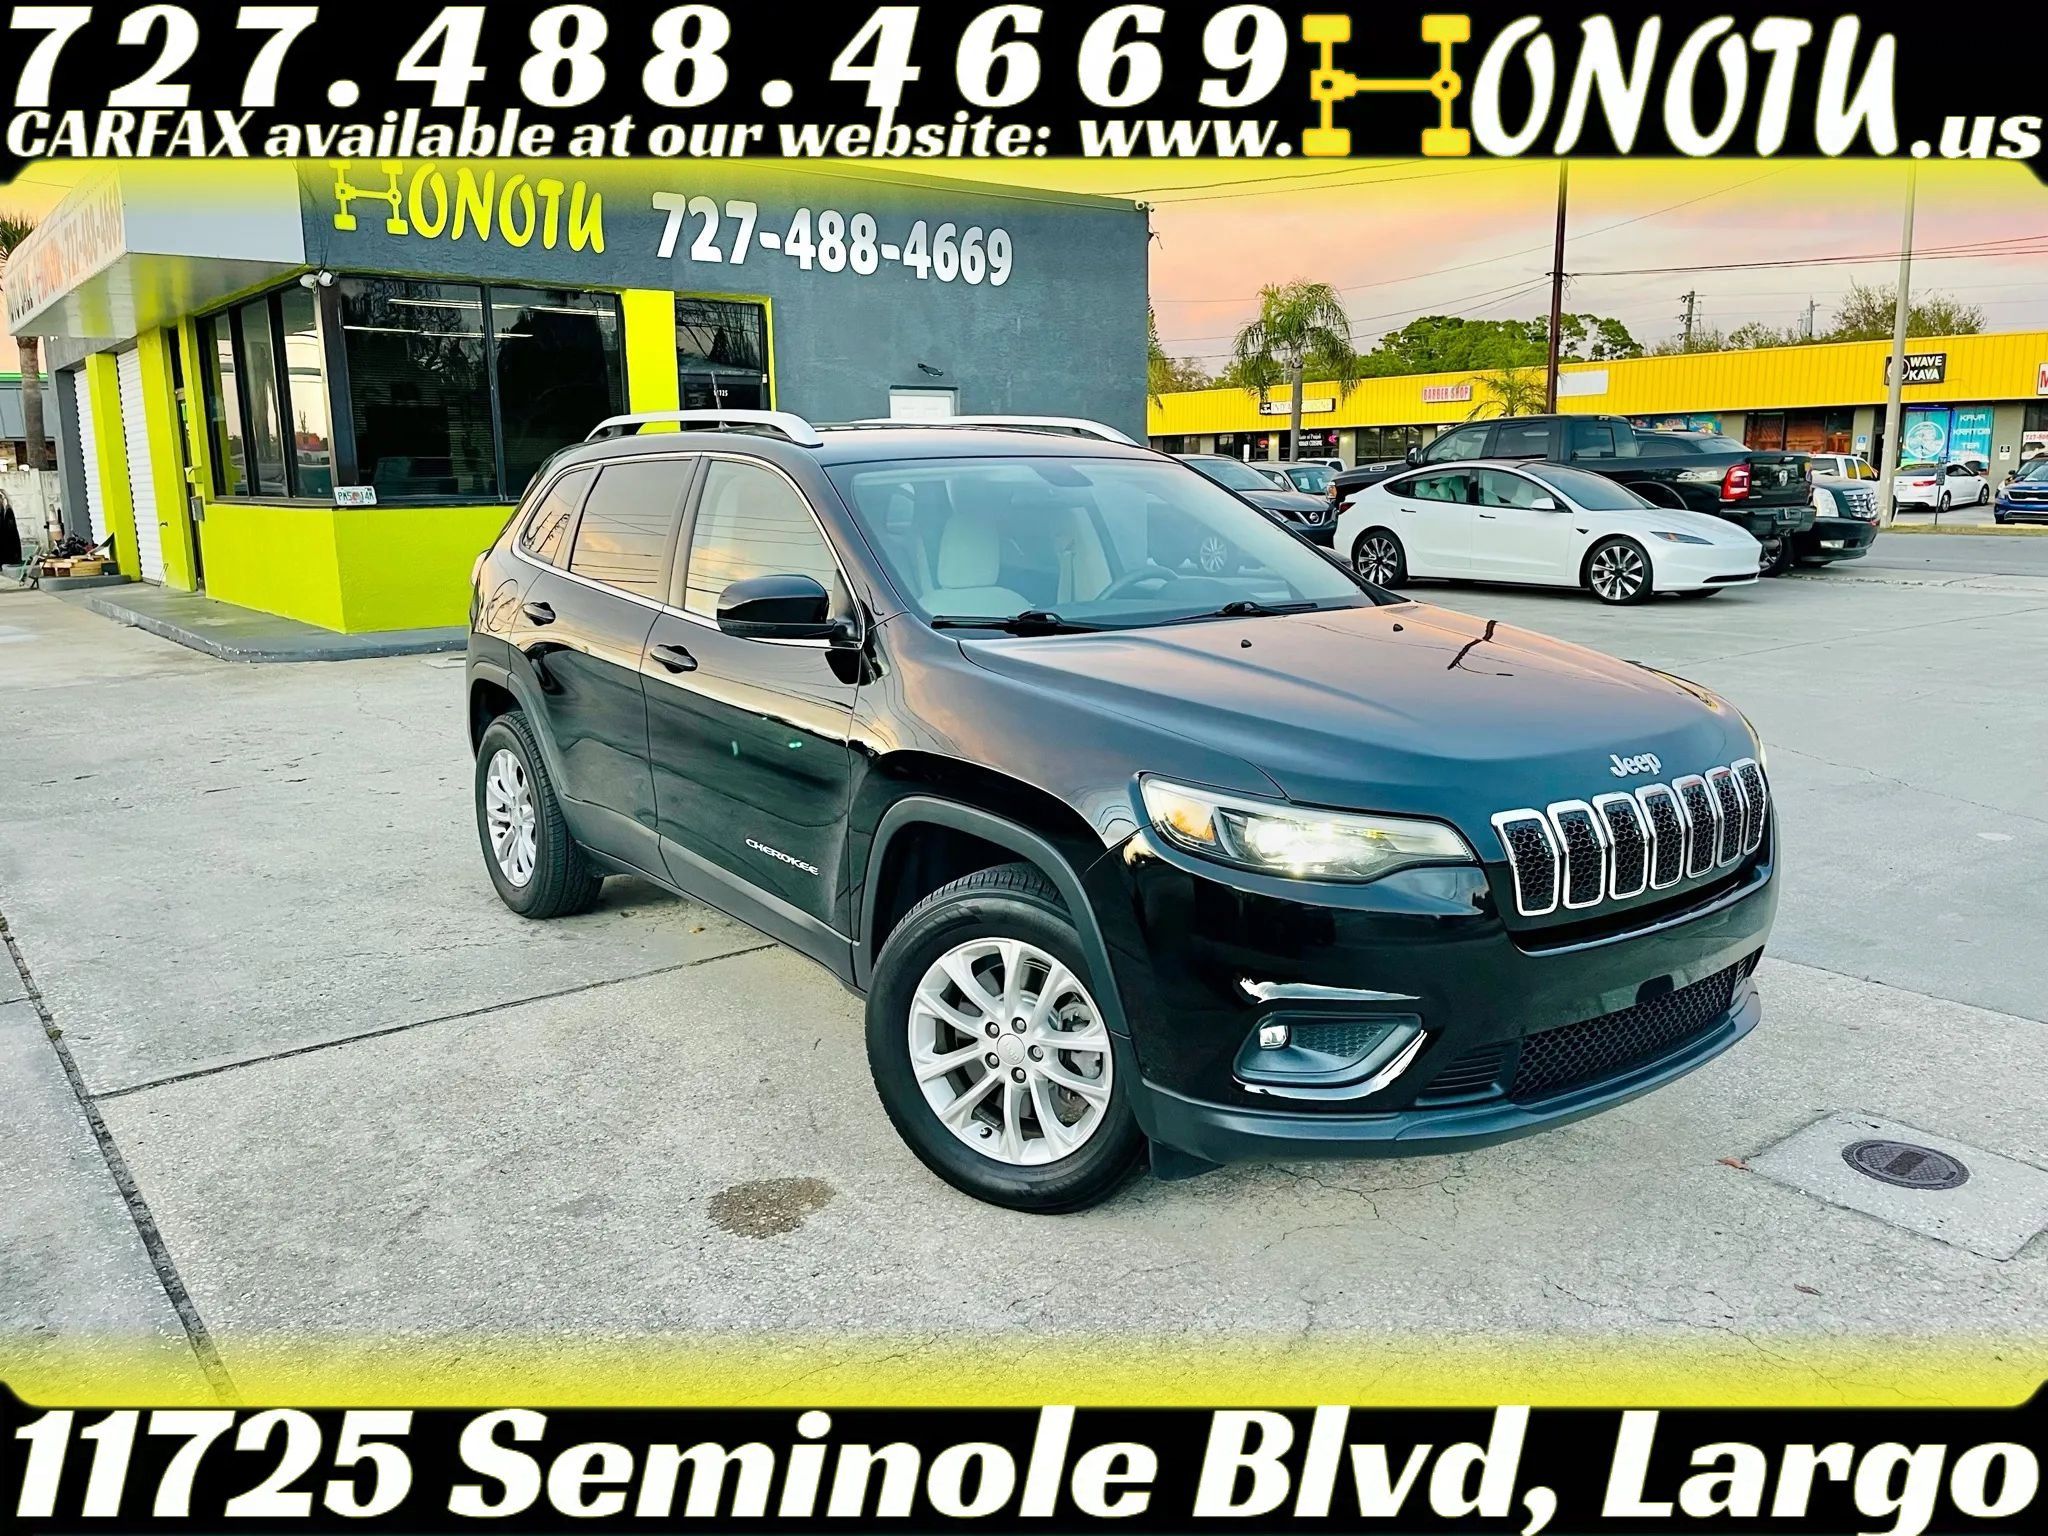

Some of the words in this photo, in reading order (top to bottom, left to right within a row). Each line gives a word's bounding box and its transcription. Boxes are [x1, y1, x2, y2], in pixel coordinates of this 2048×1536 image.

[652, 191, 1013, 286] 727-488-4669
[1910, 356, 1942, 367] WAVE
[1909, 368, 1940, 380] KAVA
[1423, 388, 1448, 400] BARBER
[1451, 386, 1469, 399] SHOP
[1959, 413, 1986, 421] KAVA
[1609, 752, 1662, 777] Jeep
[745, 838, 819, 875] CHEROKEE
